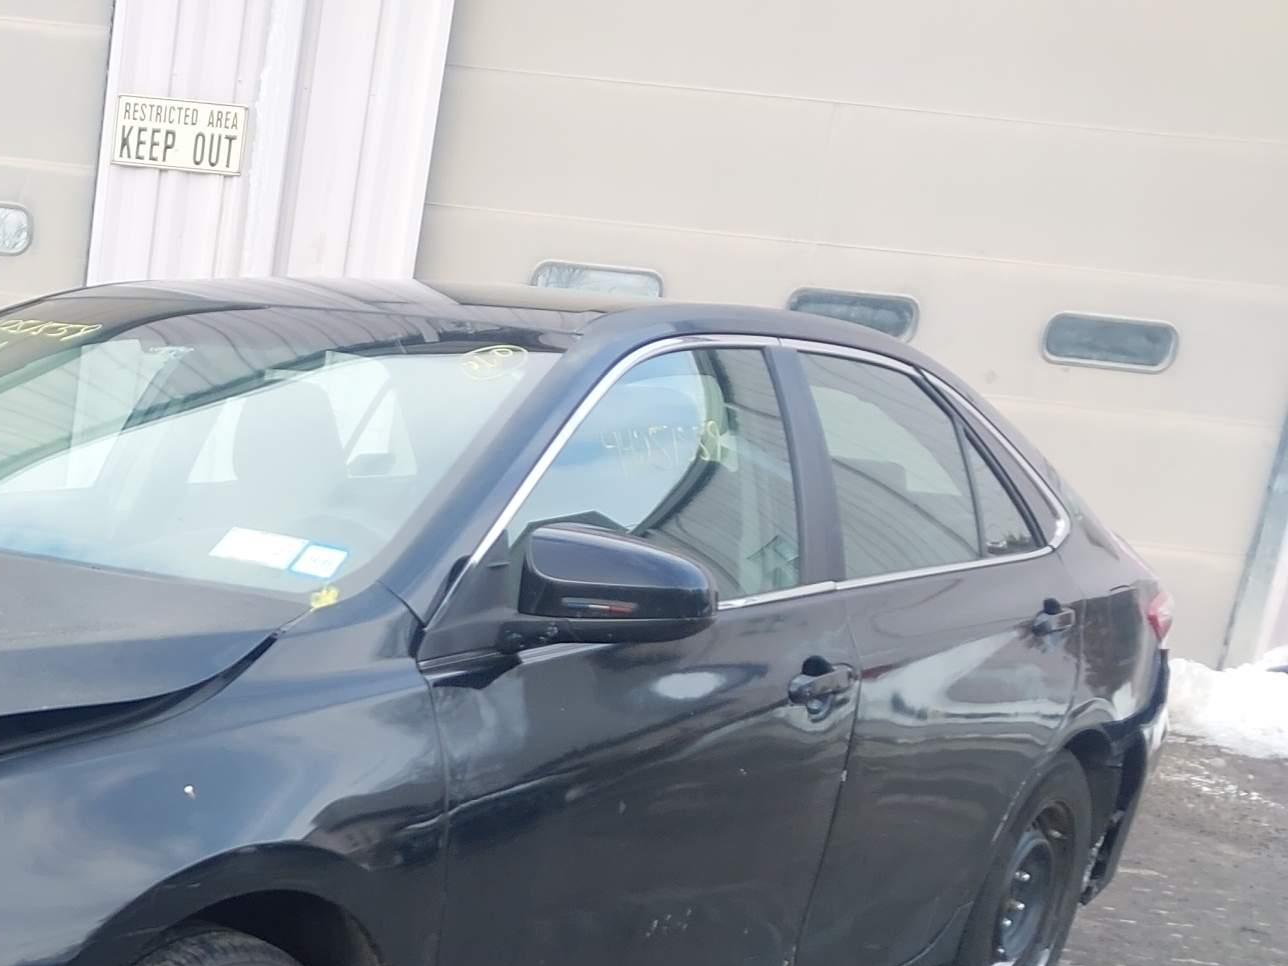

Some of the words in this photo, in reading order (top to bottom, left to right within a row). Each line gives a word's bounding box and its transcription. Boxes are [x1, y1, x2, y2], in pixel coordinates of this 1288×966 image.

[124, 102, 198, 125] RESTRICTED
[208, 110, 238, 130] AREA
[119, 125, 176, 162] KEEP
[193, 132, 237, 168] OUT
